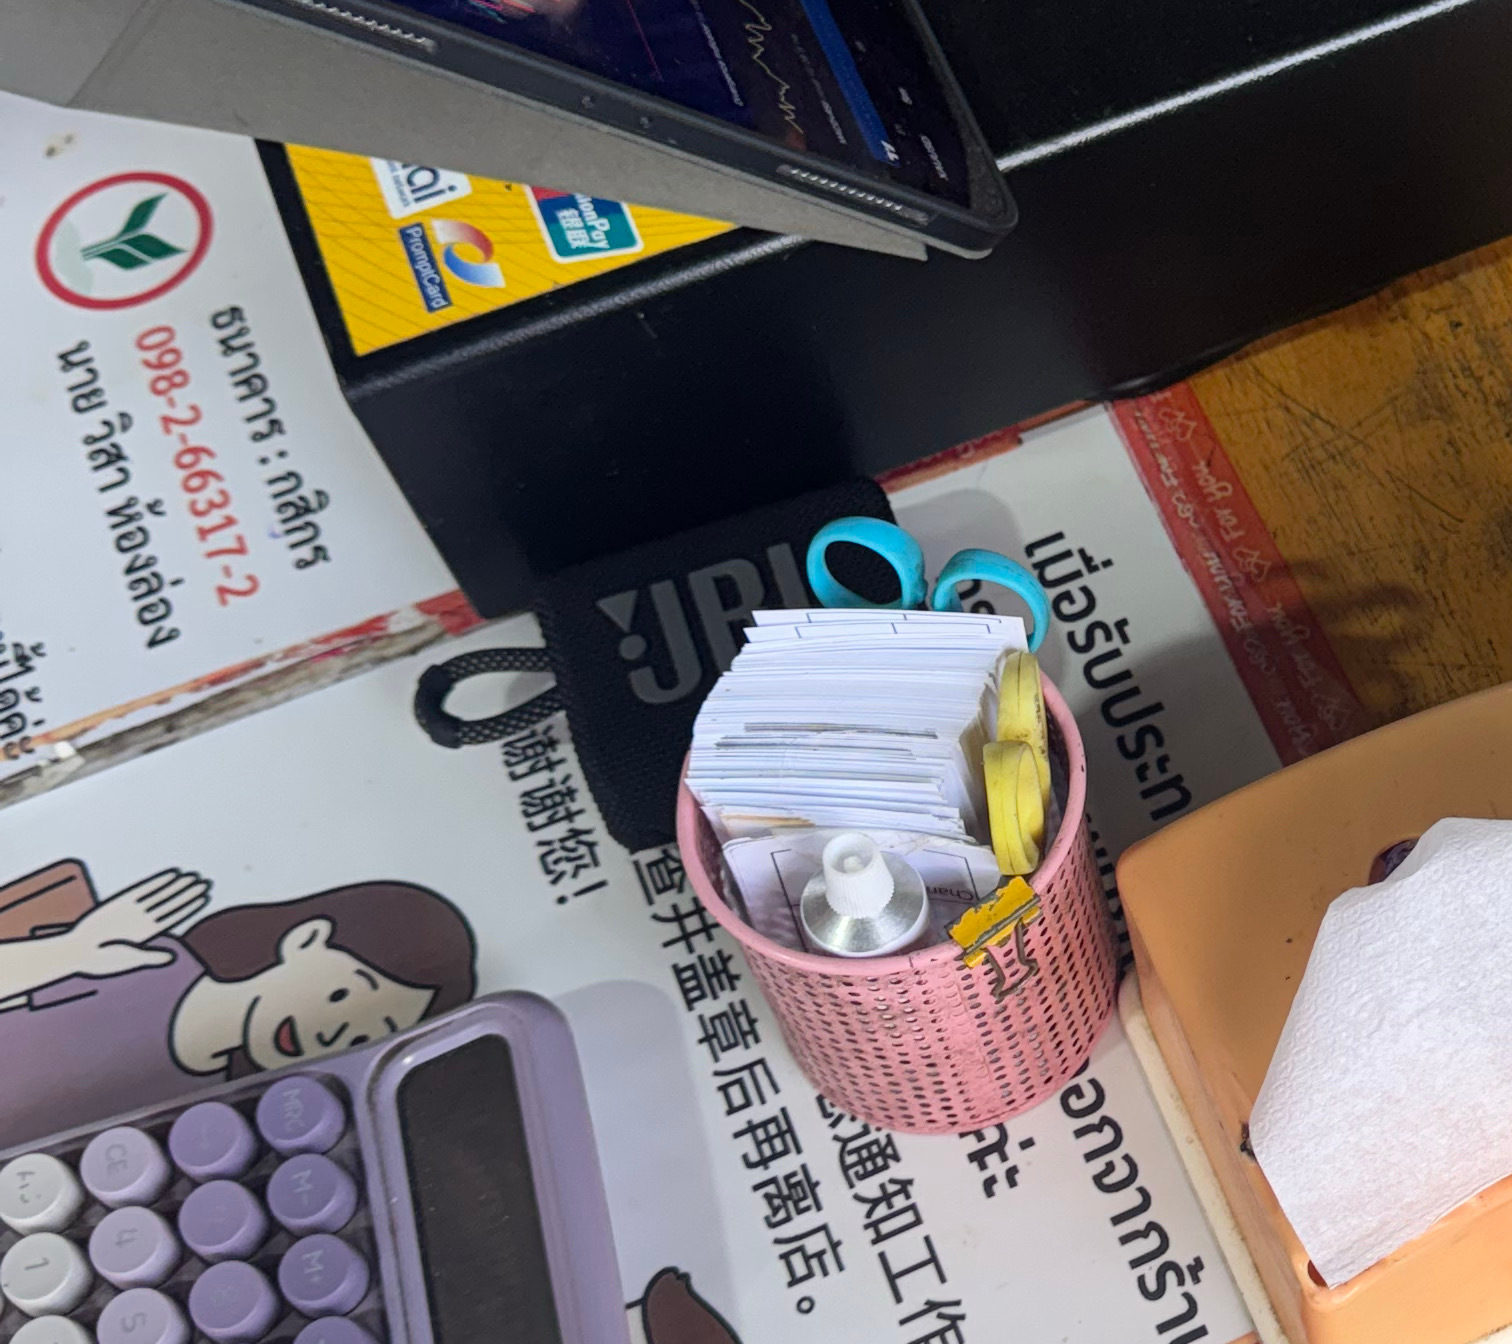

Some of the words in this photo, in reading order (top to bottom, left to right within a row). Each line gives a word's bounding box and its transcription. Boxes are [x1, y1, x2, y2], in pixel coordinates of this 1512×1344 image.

[401, 159, 456, 206] ai
[397, 222, 453, 313] PromptCard
[57, 340, 107, 415] นาย
[82, 411, 133, 493] วิสา
[135, 325, 260, 607] 098-2-66317-2
[210, 305, 286, 443] ธนาคาร
[266, 470, 330, 570] กสิกร
[1187, 457, 1237, 505] you
[1212, 504, 1246, 545] For
[105, 496, 184, 649] ห้องล่อง
[276, 1086, 313, 1135] MRC
[99, 1141, 132, 1179] CE
[116, 1310, 149, 1337] 5
